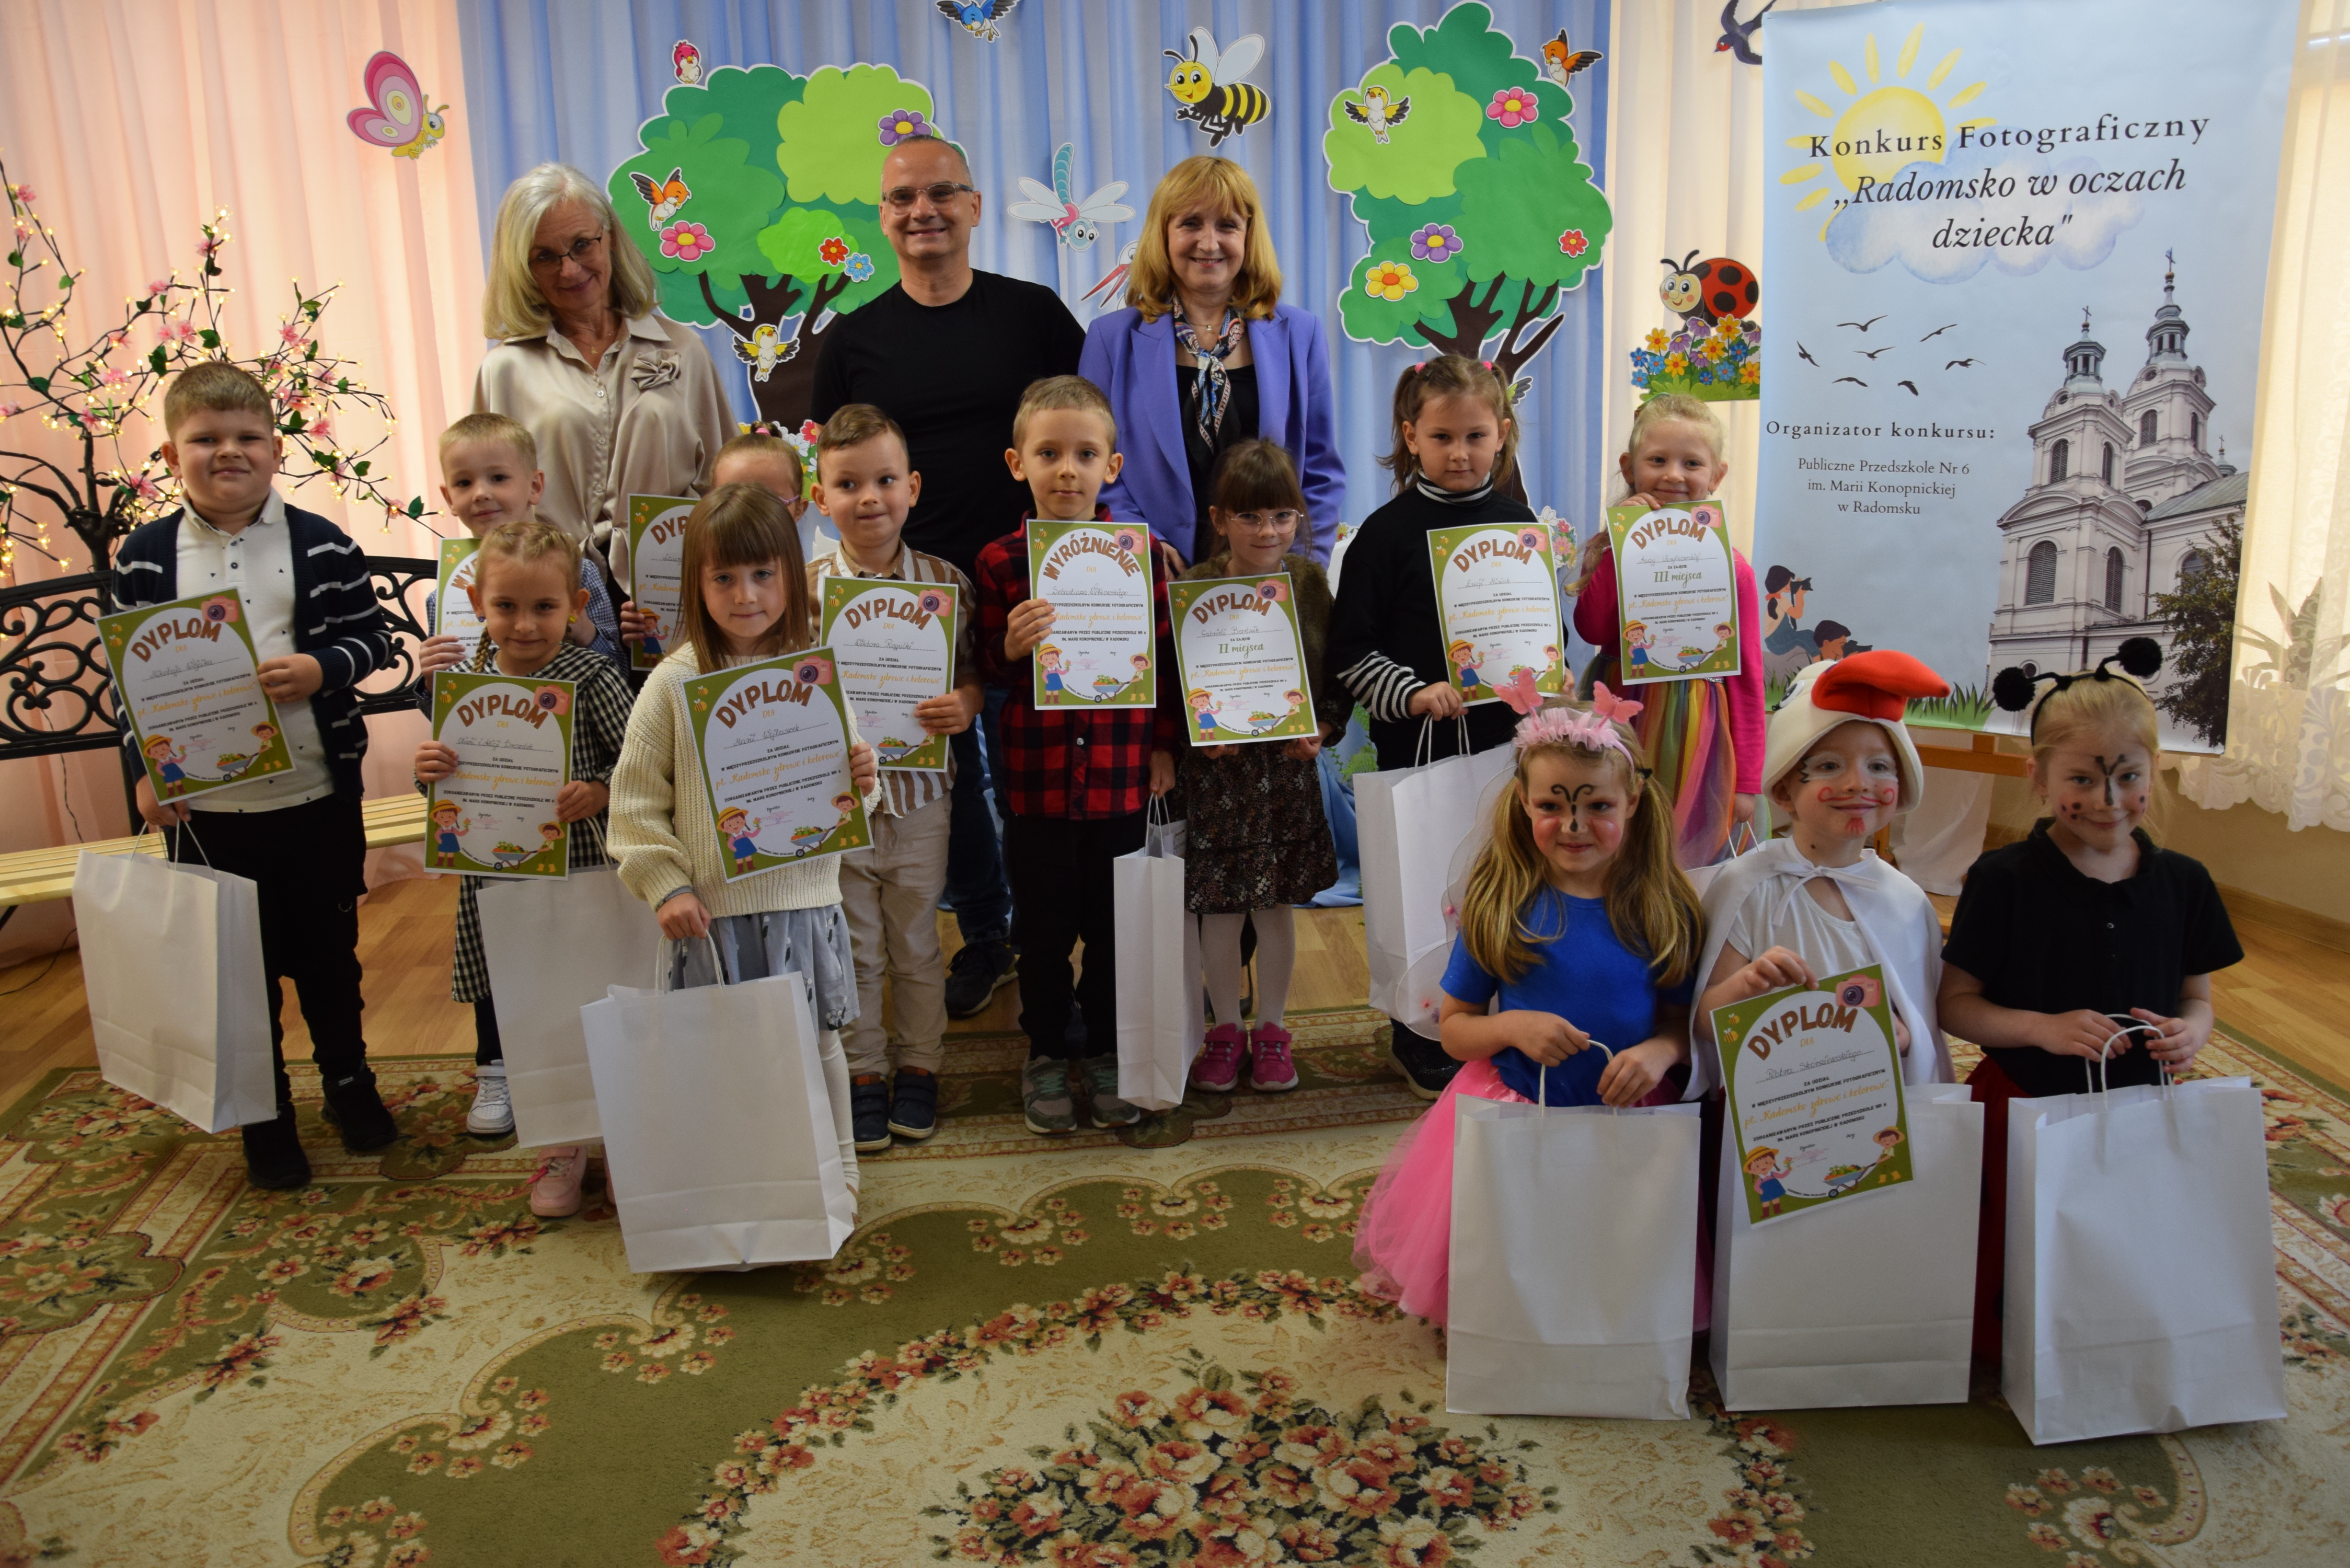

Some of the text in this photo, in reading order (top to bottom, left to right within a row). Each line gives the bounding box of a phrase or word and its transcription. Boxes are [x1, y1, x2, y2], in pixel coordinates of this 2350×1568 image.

[1808, 113, 2210, 158] Konkurs Fotograficzny
[2028, 174, 2057, 197] w
[2069, 158, 2187, 196] oczach
[1766, 421, 1995, 439] Organizator konkursu:
[1798, 458, 1969, 474] Publiczne Przedszkole Nr 6
[1807, 479, 1955, 499] im. Marii Konopnickiej
[1838, 501, 1920, 514] w Radomsku
[650, 515, 690, 545] DYP
[1631, 517, 1706, 549] DYPLOM
[1043, 532, 1141, 580] WYRÓŻNIENIE
[1453, 539, 1532, 572] DYPLOM
[1654, 571, 1702, 589] III miejsca
[845, 598, 931, 630] DYPLOM
[1088, 612, 1110, 628] zdrowe
[1192, 593, 1271, 624] DYPLOM
[131, 618, 222, 663] DYPLOM
[1218, 643, 1264, 659] II miejsca
[878, 673, 904, 688] zdrowe
[457, 695, 548, 729] DYPLOM
[716, 680, 813, 729] DYPLOM
[763, 709, 775, 718] DLA
[802, 740, 838, 751] FOTOGRAFICZNYM
[774, 761, 799, 781] zdrowe
[1747, 1003, 1858, 1060] DYPLOM
[1800, 1037, 1814, 1047] DLA
[1843, 1069, 1885, 1083] FOTOGRAFICZNYM
[1810, 1094, 1840, 1118] zdrowe
[1843, 1090, 1847, 1099] i
